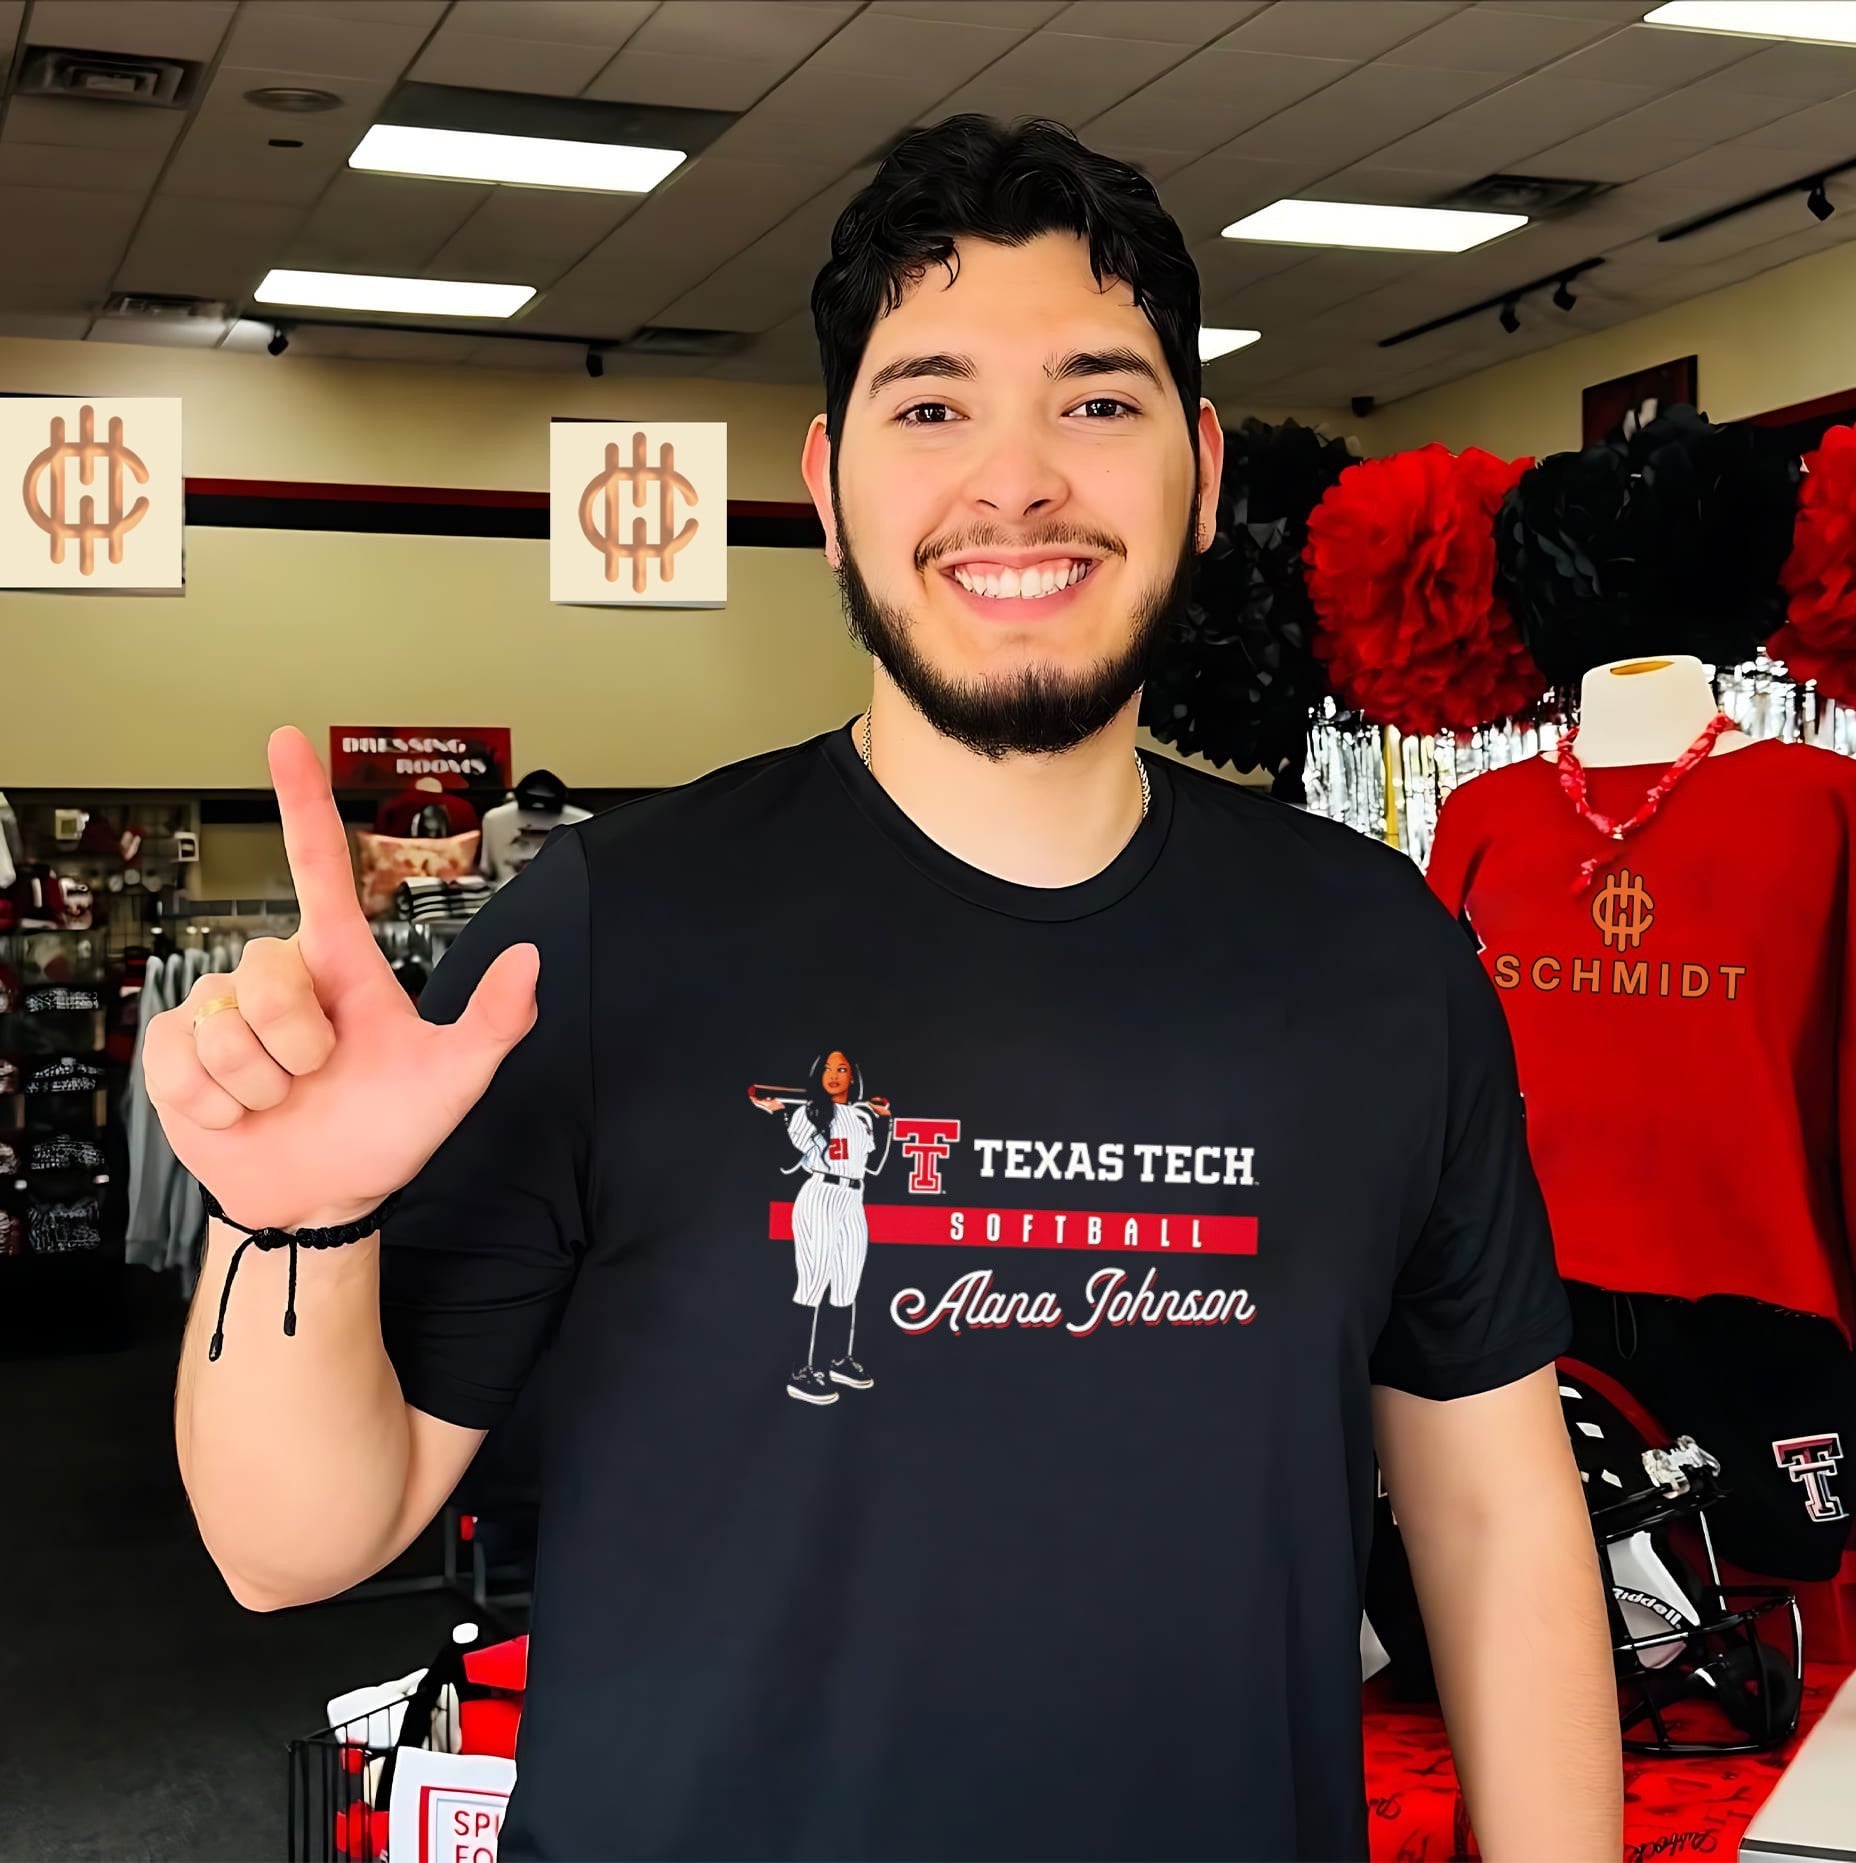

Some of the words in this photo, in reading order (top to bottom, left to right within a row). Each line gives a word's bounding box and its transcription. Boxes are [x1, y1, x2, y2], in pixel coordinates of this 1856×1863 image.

[342, 737, 467, 753] DRESSING
[396, 758, 487, 775] ROOMS
[1494, 954, 1747, 1000] SCHMIDT
[829, 1138, 849, 1161] 21
[973, 1139, 1124, 1182] TEXAS
[1133, 1144, 1255, 1185] TECH
[950, 1212, 1202, 1248] SOFTBALL
[890, 1269, 1062, 1335] Alana
[1066, 1267, 1257, 1337] Johnson
